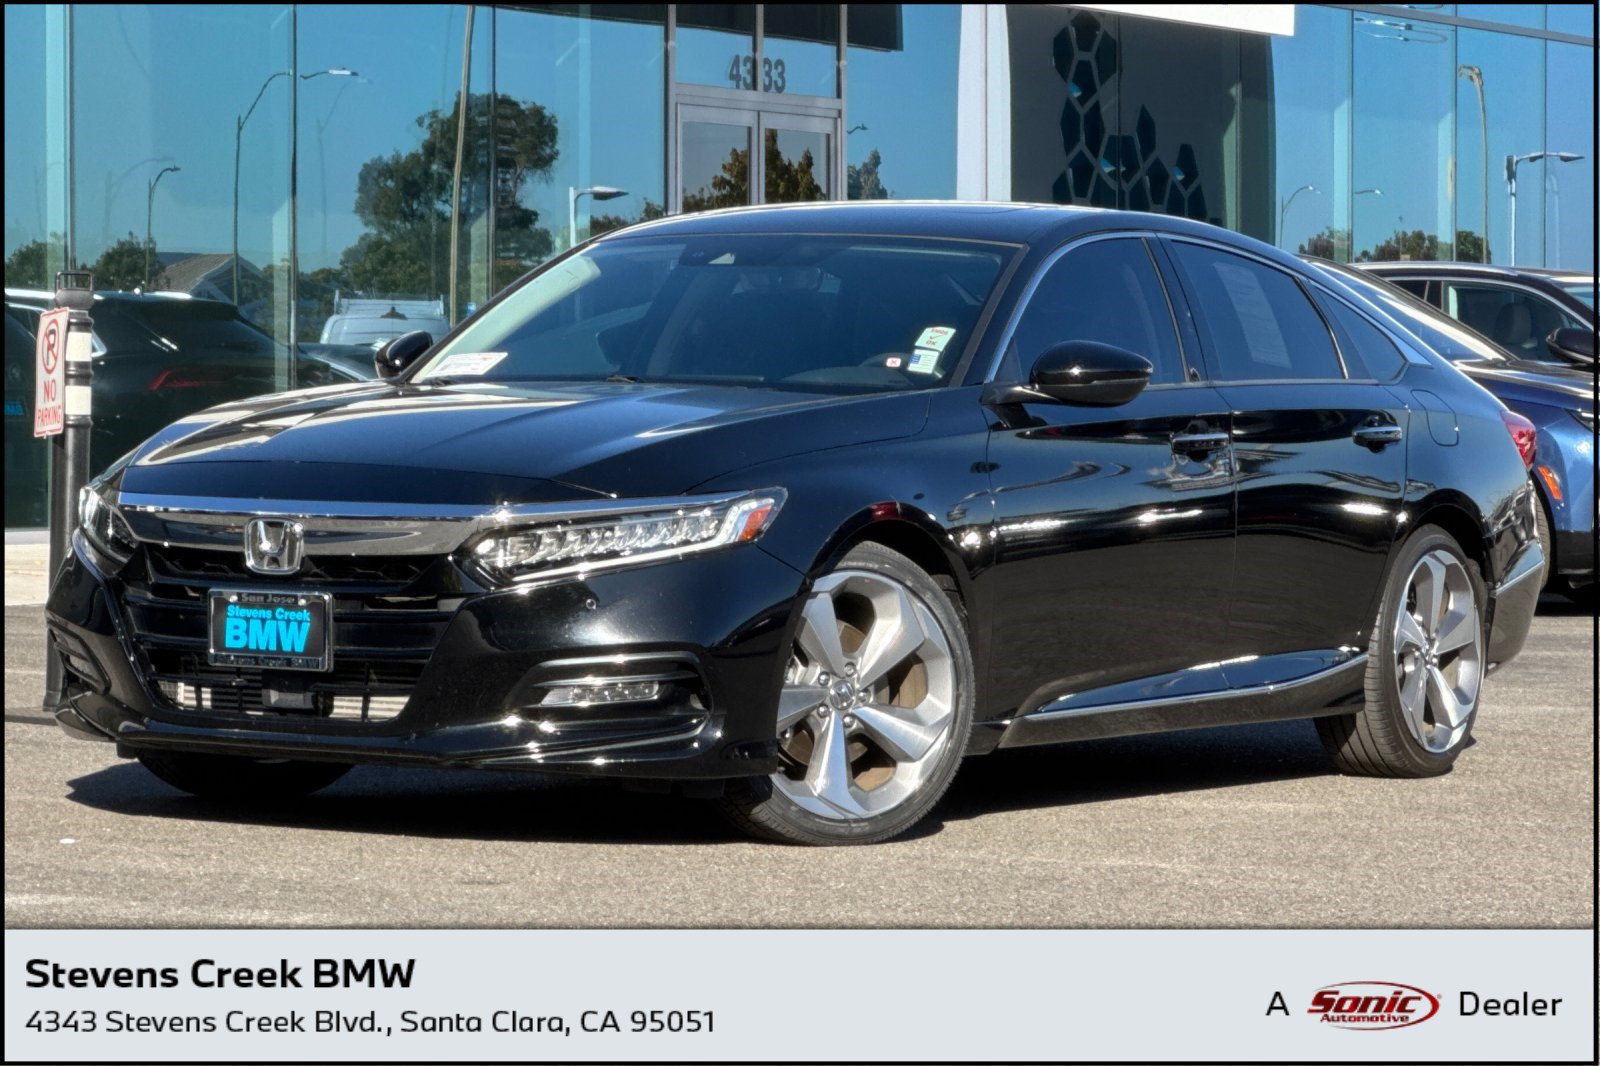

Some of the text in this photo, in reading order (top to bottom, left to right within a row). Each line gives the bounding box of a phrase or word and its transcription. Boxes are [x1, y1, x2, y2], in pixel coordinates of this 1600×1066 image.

[729, 54, 786, 94] 4333
[43, 379, 56, 402] NO
[37, 405, 61, 426] PARKING
[227, 604, 311, 621] Stevens Creek
[225, 617, 311, 653] BMW
